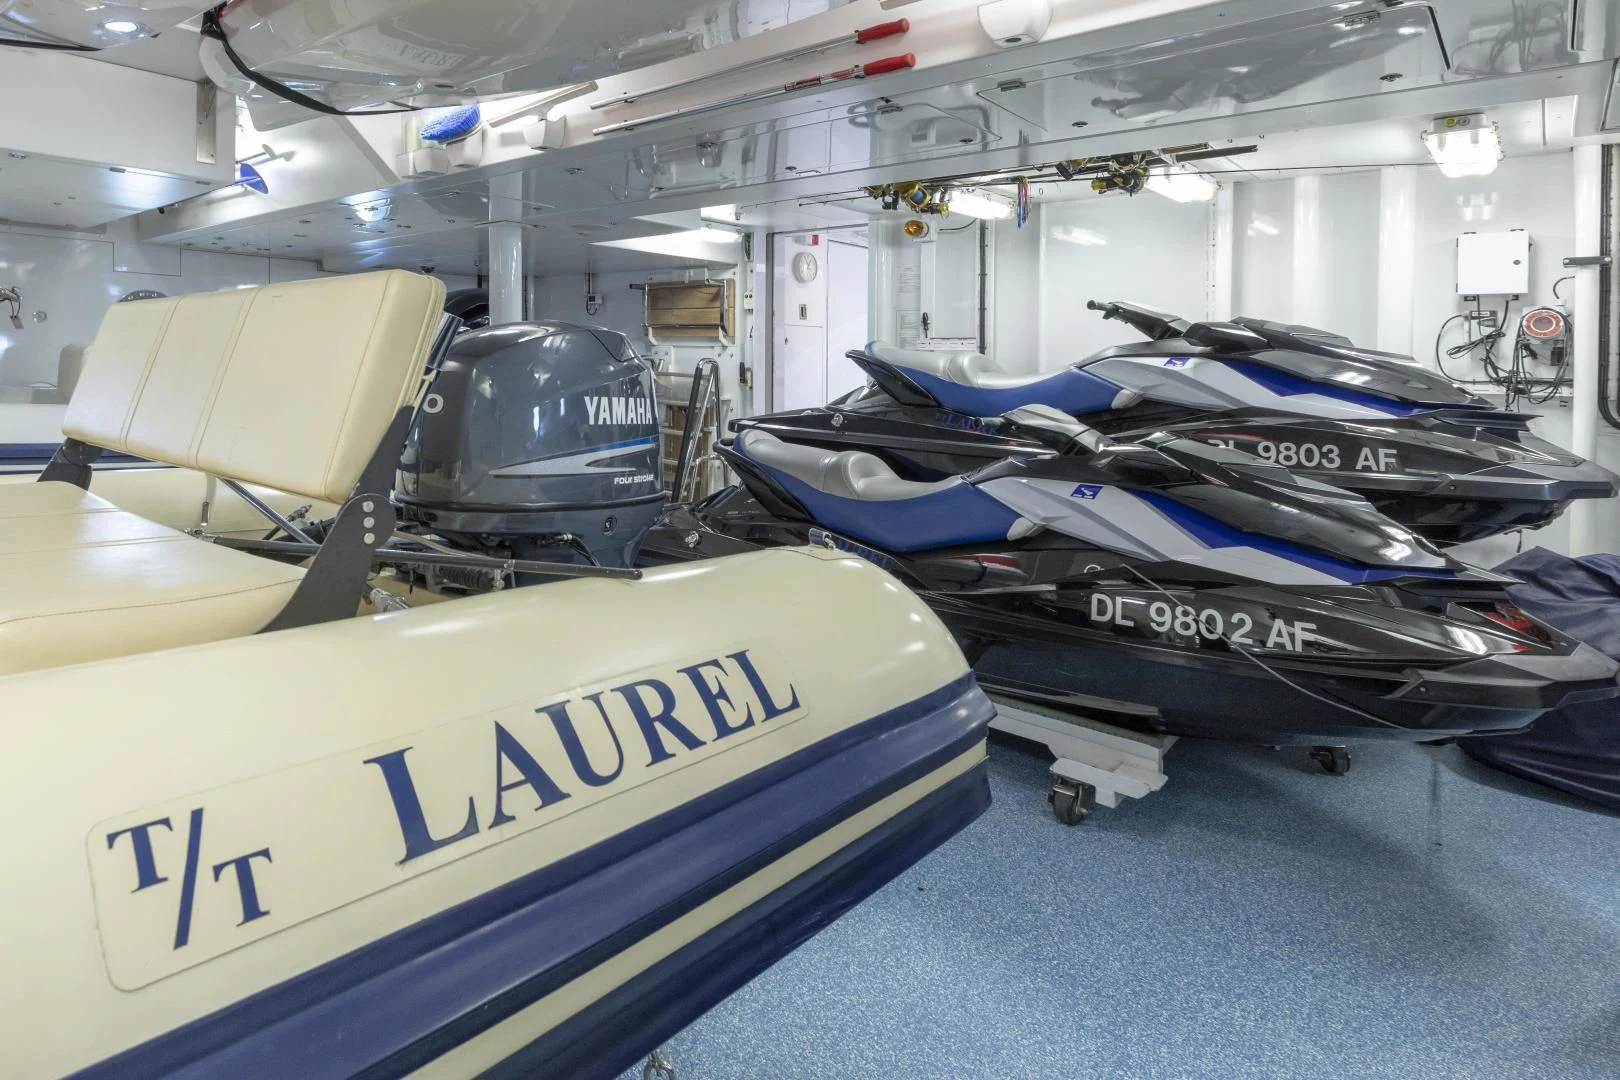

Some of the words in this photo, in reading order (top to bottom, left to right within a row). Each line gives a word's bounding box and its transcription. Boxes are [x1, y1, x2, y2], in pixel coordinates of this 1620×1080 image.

[584, 396, 653, 425] YAMAHA
[1257, 441, 1341, 469] 9803
[1355, 447, 1398, 472] AF
[1090, 593, 1134, 627] DL
[1266, 618, 1317, 652] AF
[106, 807, 273, 951] T/T
[362, 649, 801, 867] LAUREL
